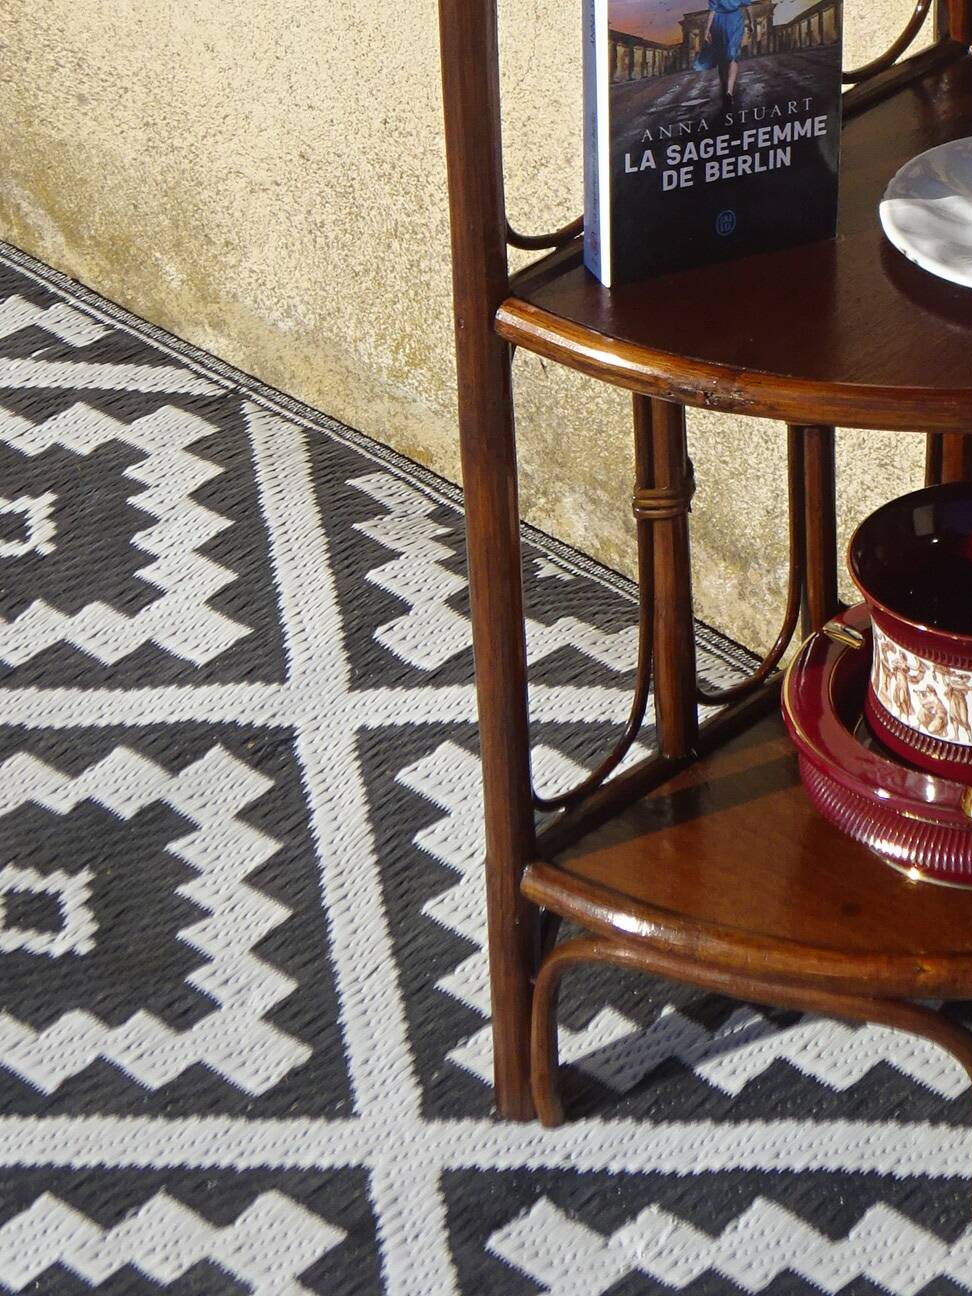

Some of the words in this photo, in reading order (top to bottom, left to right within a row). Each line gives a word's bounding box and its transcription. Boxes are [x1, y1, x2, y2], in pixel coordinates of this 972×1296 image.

[641, 118, 709, 143] ANNA
[725, 97, 813, 126] STUART
[624, 149, 656, 173] LA
[666, 115, 828, 166] SAGE-FEMME
[662, 166, 694, 192] DE
[705, 146, 791, 183] BERLIN
